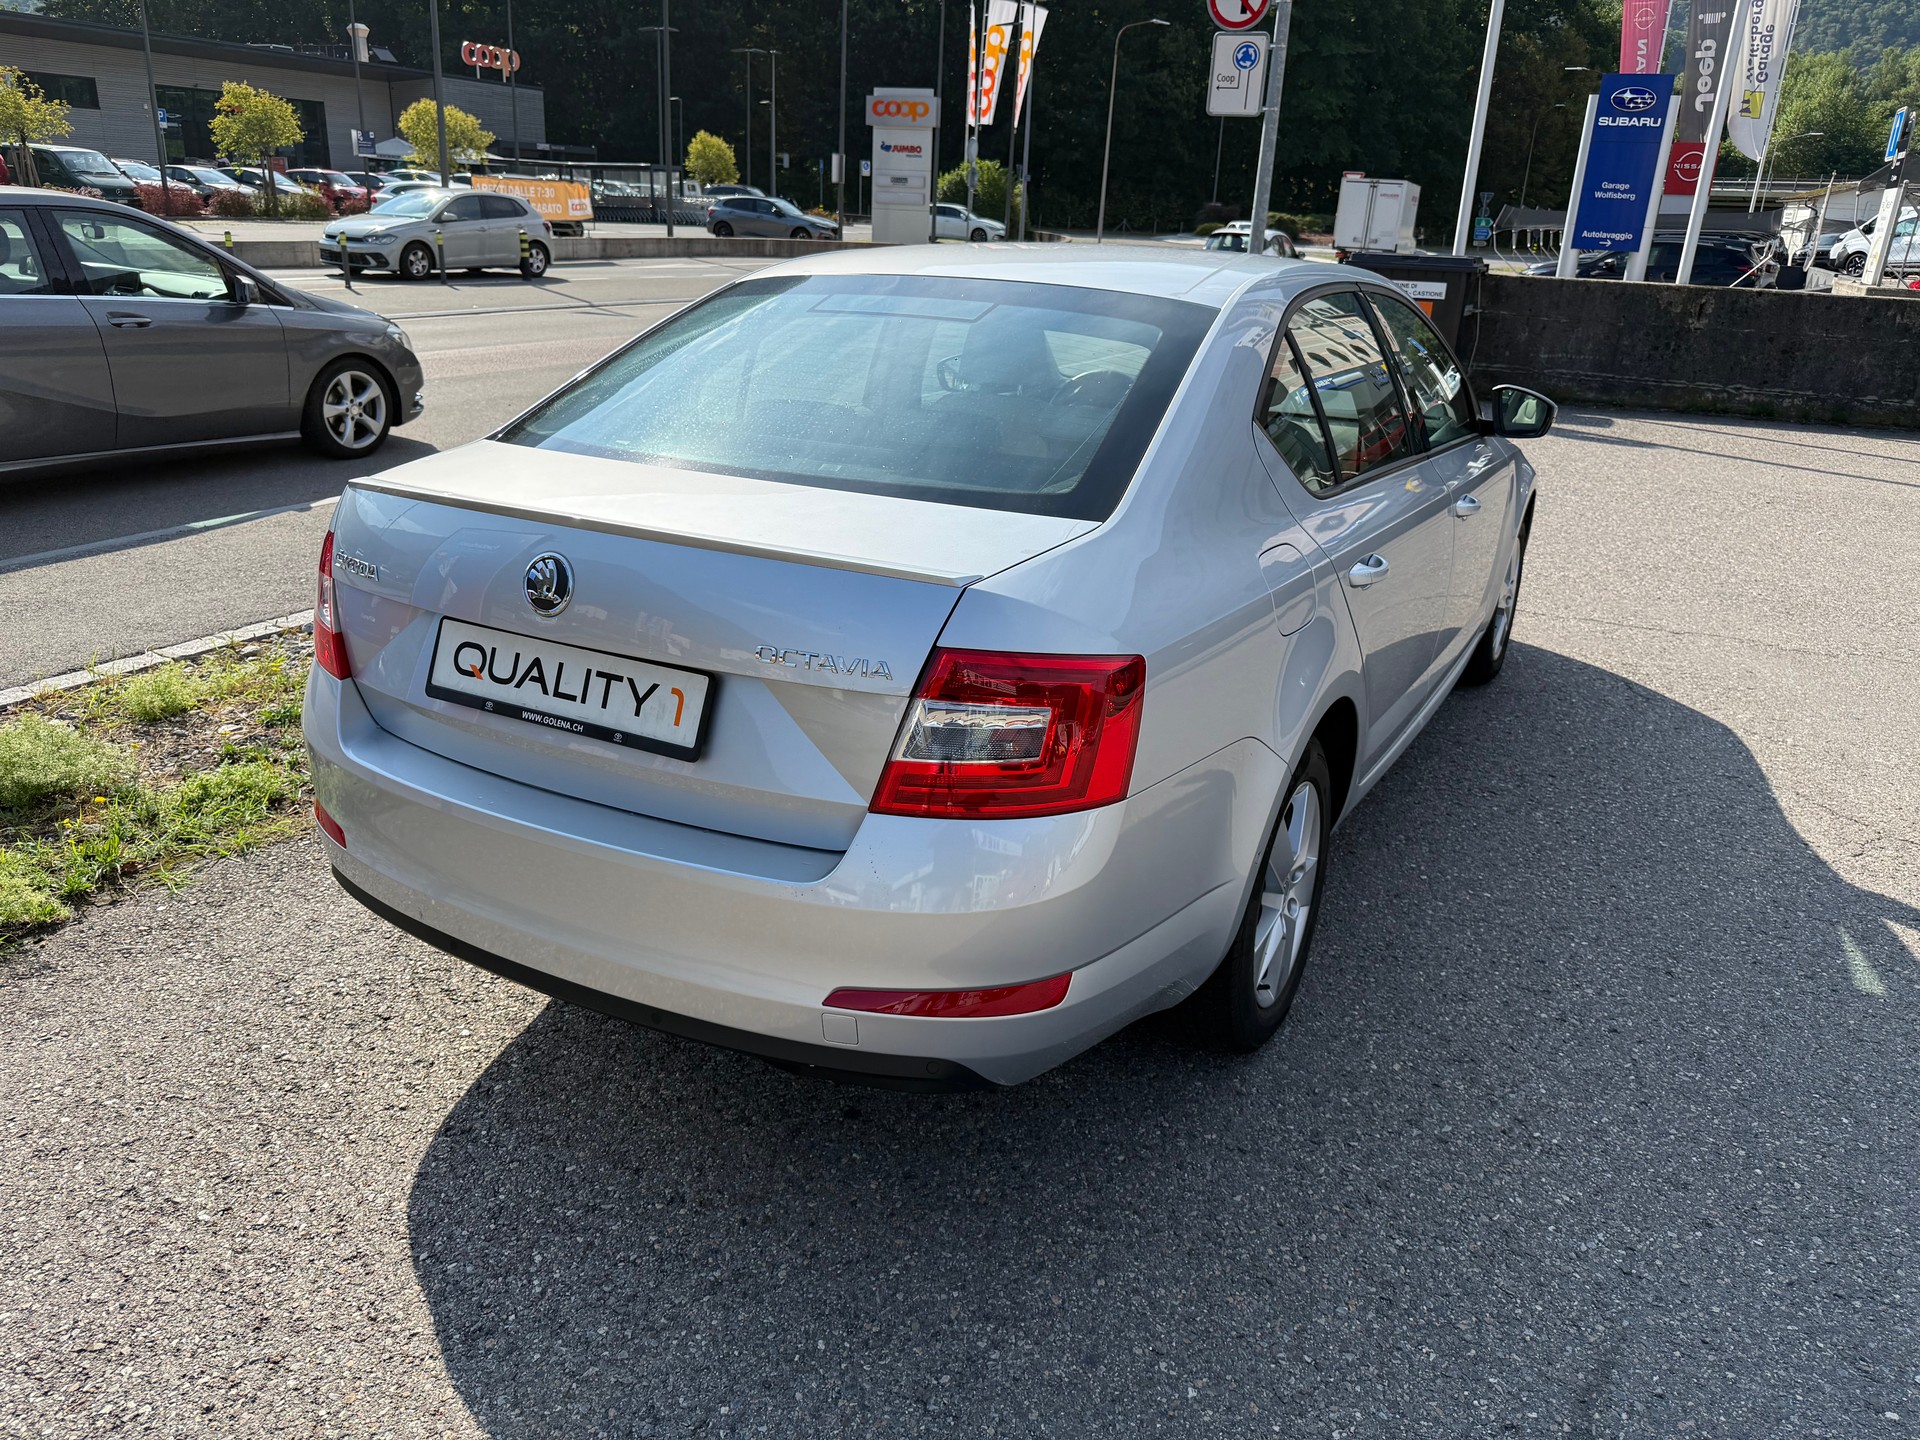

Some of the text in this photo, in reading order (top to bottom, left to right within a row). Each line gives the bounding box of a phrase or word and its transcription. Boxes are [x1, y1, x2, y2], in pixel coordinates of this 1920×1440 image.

[461, 41, 521, 78] coop
[1216, 73, 1235, 85] Coop
[872, 99, 930, 122] coop
[1598, 116, 1662, 127] SUBARU
[891, 144, 922, 154] JUMBO
[1601, 181, 1630, 190] Garage
[508, 186, 536, 197] DALLE
[536, 187, 555, 198] 7:30
[1594, 191, 1636, 201] Wolfisberg
[1581, 230, 1633, 241] Autolavaggio
[754, 644, 893, 681] OCTAVIA
[454, 641, 685, 727] QUALITY 1
[522, 710, 584, 733] WWW.GOLENA.CH
